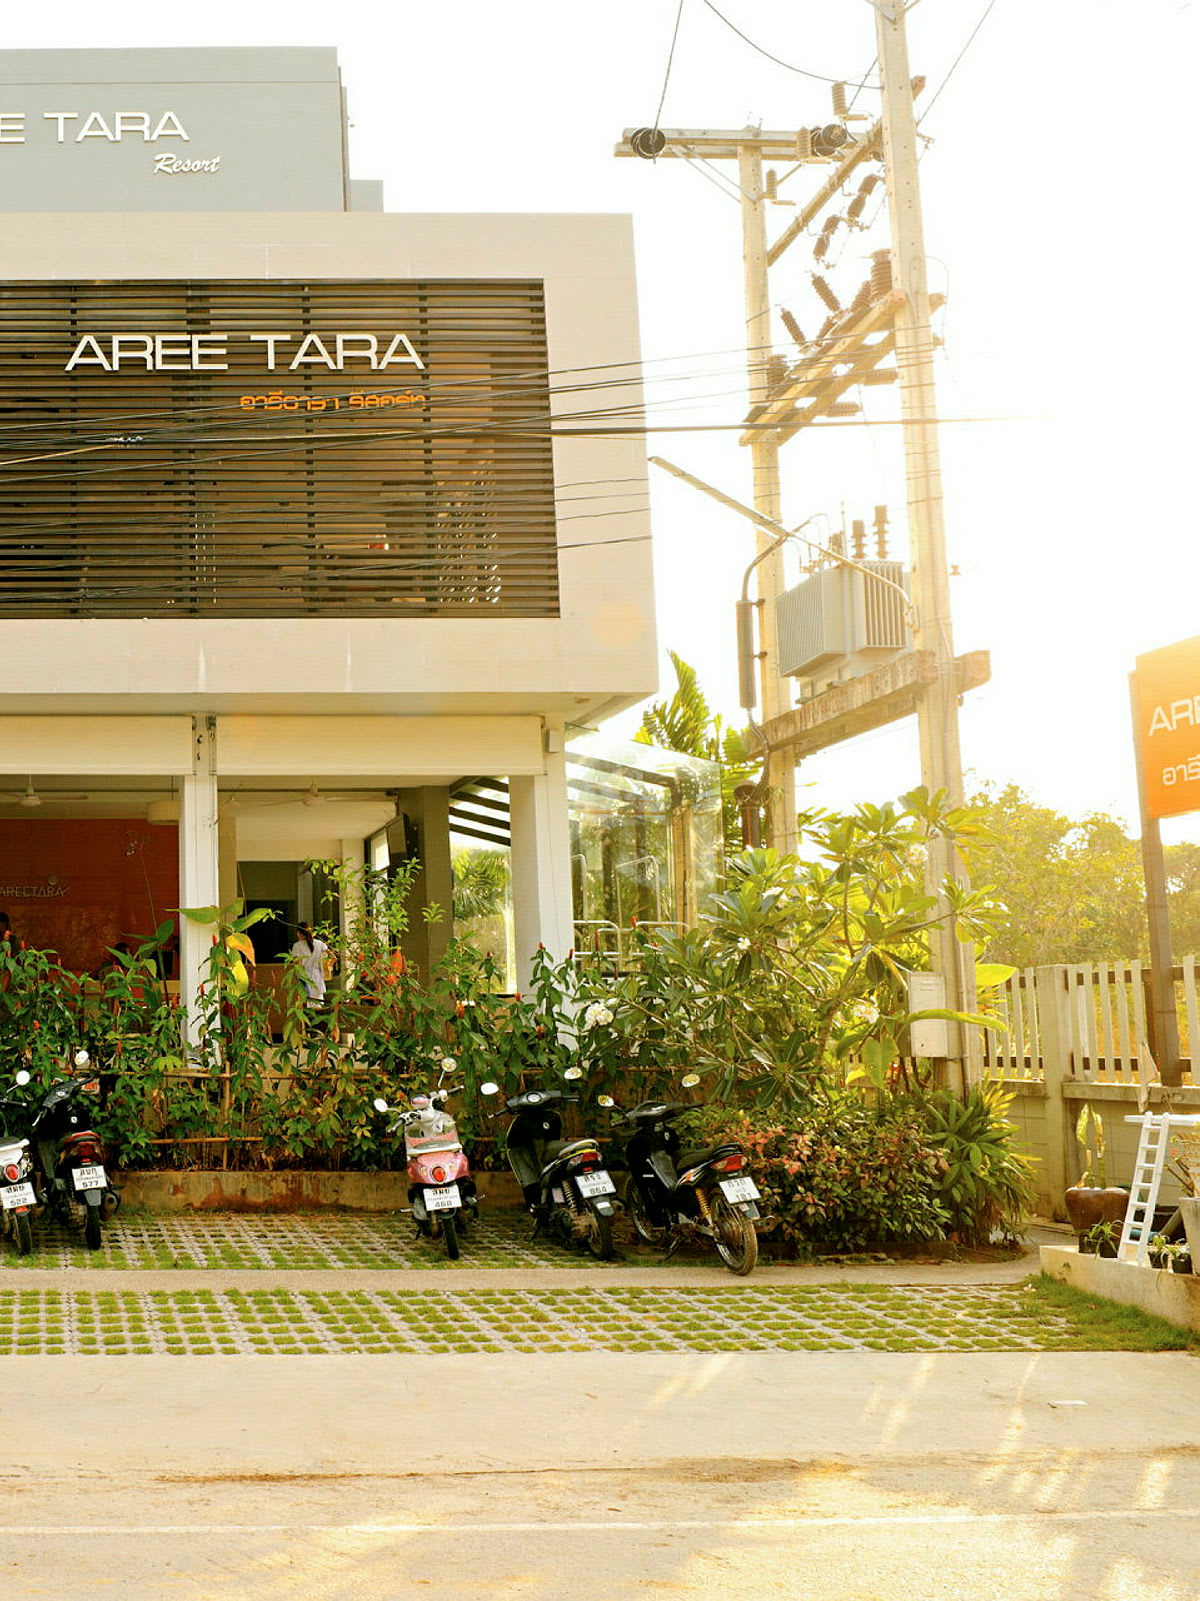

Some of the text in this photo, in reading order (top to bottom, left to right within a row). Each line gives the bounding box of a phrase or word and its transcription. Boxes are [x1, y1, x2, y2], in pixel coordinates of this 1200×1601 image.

[43, 111, 190, 142] TARA
[153, 152, 220, 175] Resort
[65, 333, 426, 372] AREE TARA
